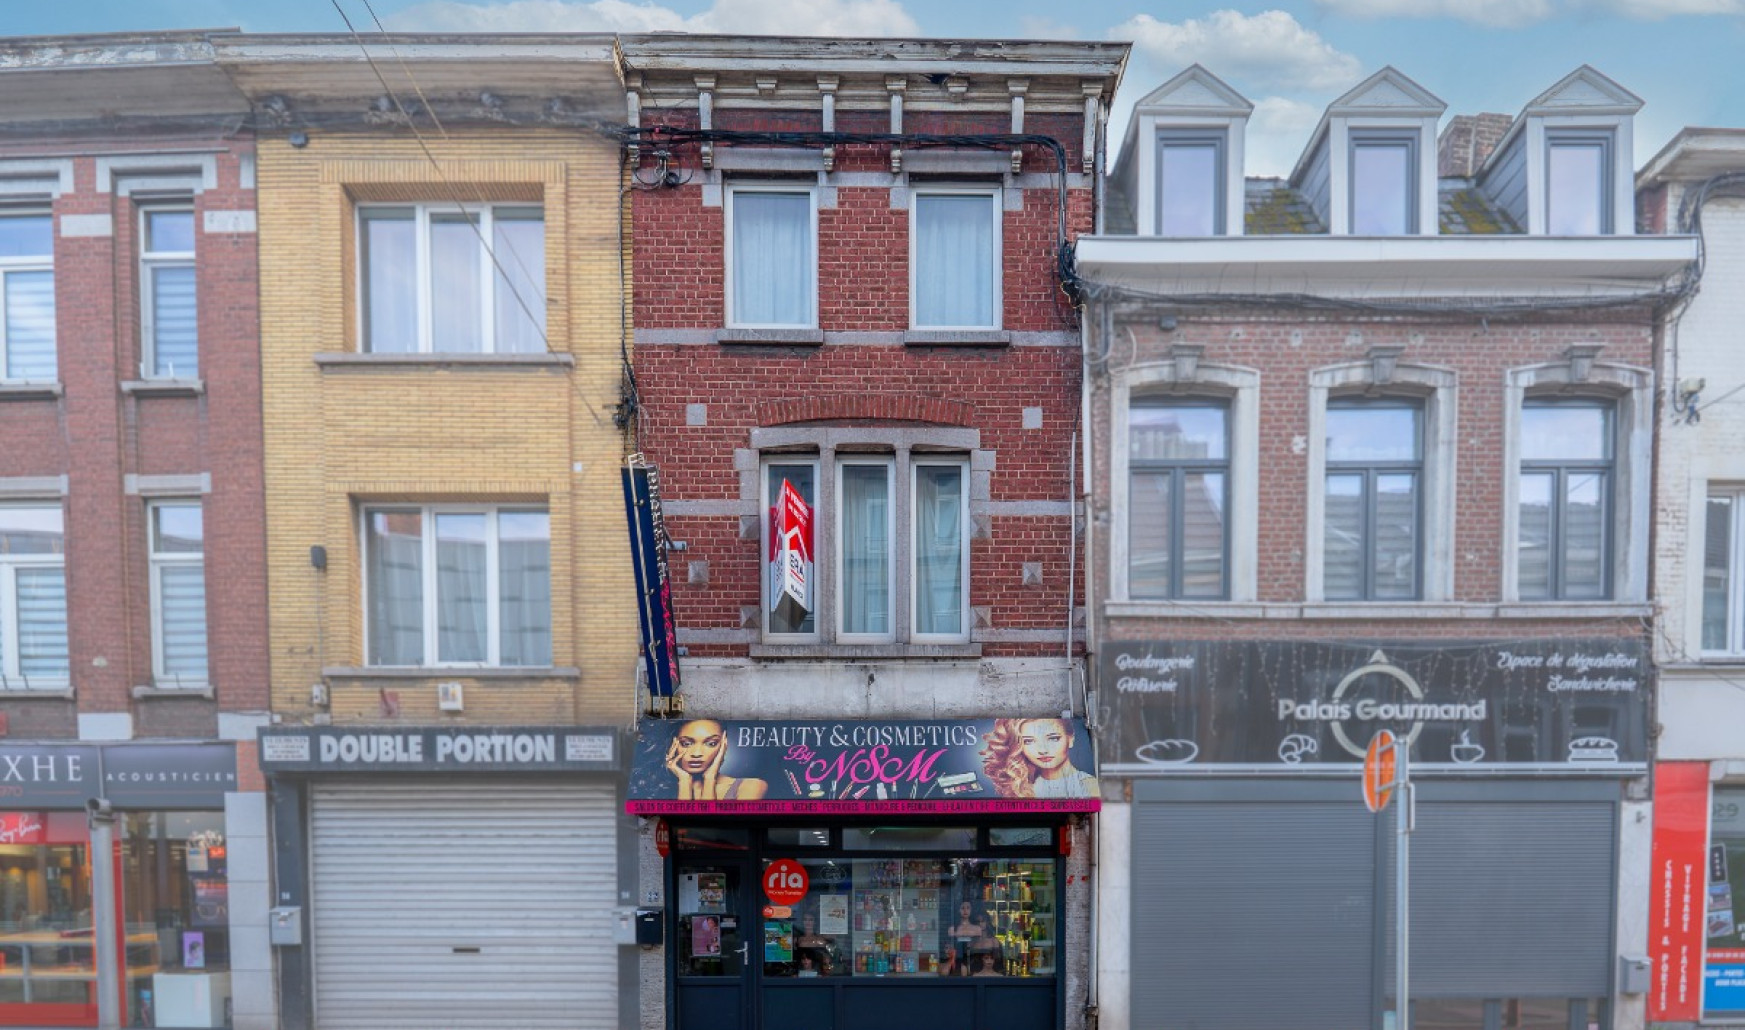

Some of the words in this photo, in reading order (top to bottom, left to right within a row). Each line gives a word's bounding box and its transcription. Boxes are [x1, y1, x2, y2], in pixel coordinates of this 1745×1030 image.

[1497, 651, 1544, 672] Espace
[1546, 652, 1564, 668] de
[1566, 651, 1639, 673] dégustation
[1547, 674, 1638, 692] Sandwicherie
[1278, 699, 1351, 721] Palais
[1355, 699, 1487, 721] Gourmand
[737, 726, 829, 747] BEAUTY
[829, 724, 850, 747] &
[852, 725, 978, 746] COSMETICS
[319, 735, 424, 763] DOUBLE
[436, 735, 556, 763] PORTION
[783, 744, 817, 764] By
[2, 754, 84, 782] XHE
[805, 744, 949, 784] NSM
[106, 772, 235, 782] ACOUSTICIEN
[768, 864, 804, 888] ria
[1663, 859, 1673, 929] CHASSIS
[1681, 863, 1693, 933] VITRAGE
[1660, 952, 1671, 1012] PORTES
